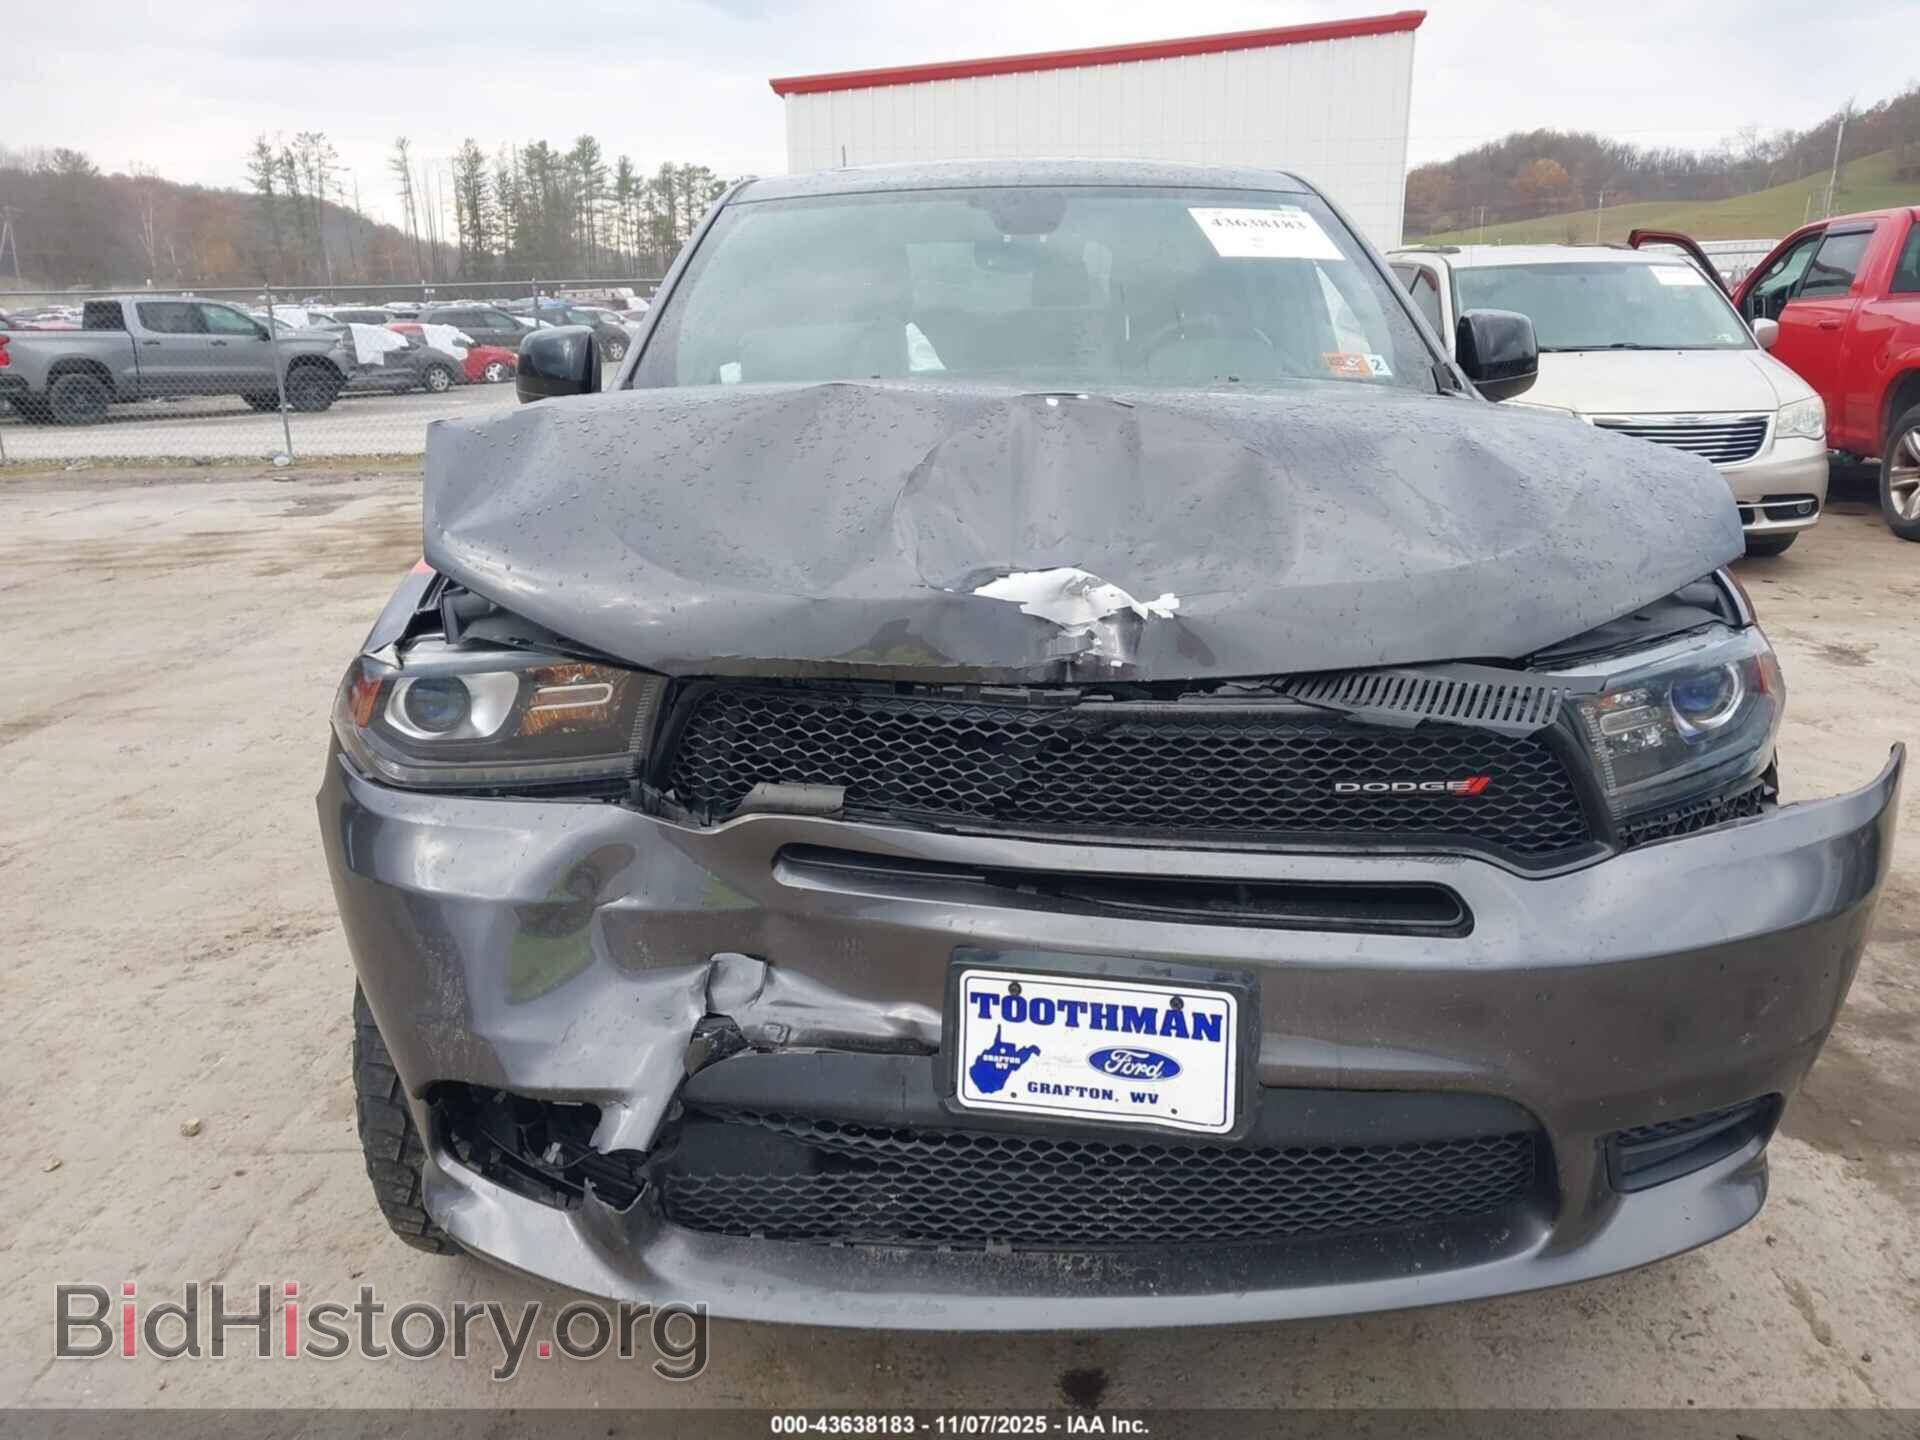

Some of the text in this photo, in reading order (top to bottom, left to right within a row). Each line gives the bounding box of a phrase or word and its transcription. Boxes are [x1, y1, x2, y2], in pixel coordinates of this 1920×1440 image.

[1335, 781, 1472, 793] DODGE
[969, 991, 1223, 1043] TOOTHMAN
[1104, 1049, 1165, 1080] Ford
[1130, 1092, 1159, 1105] WV
